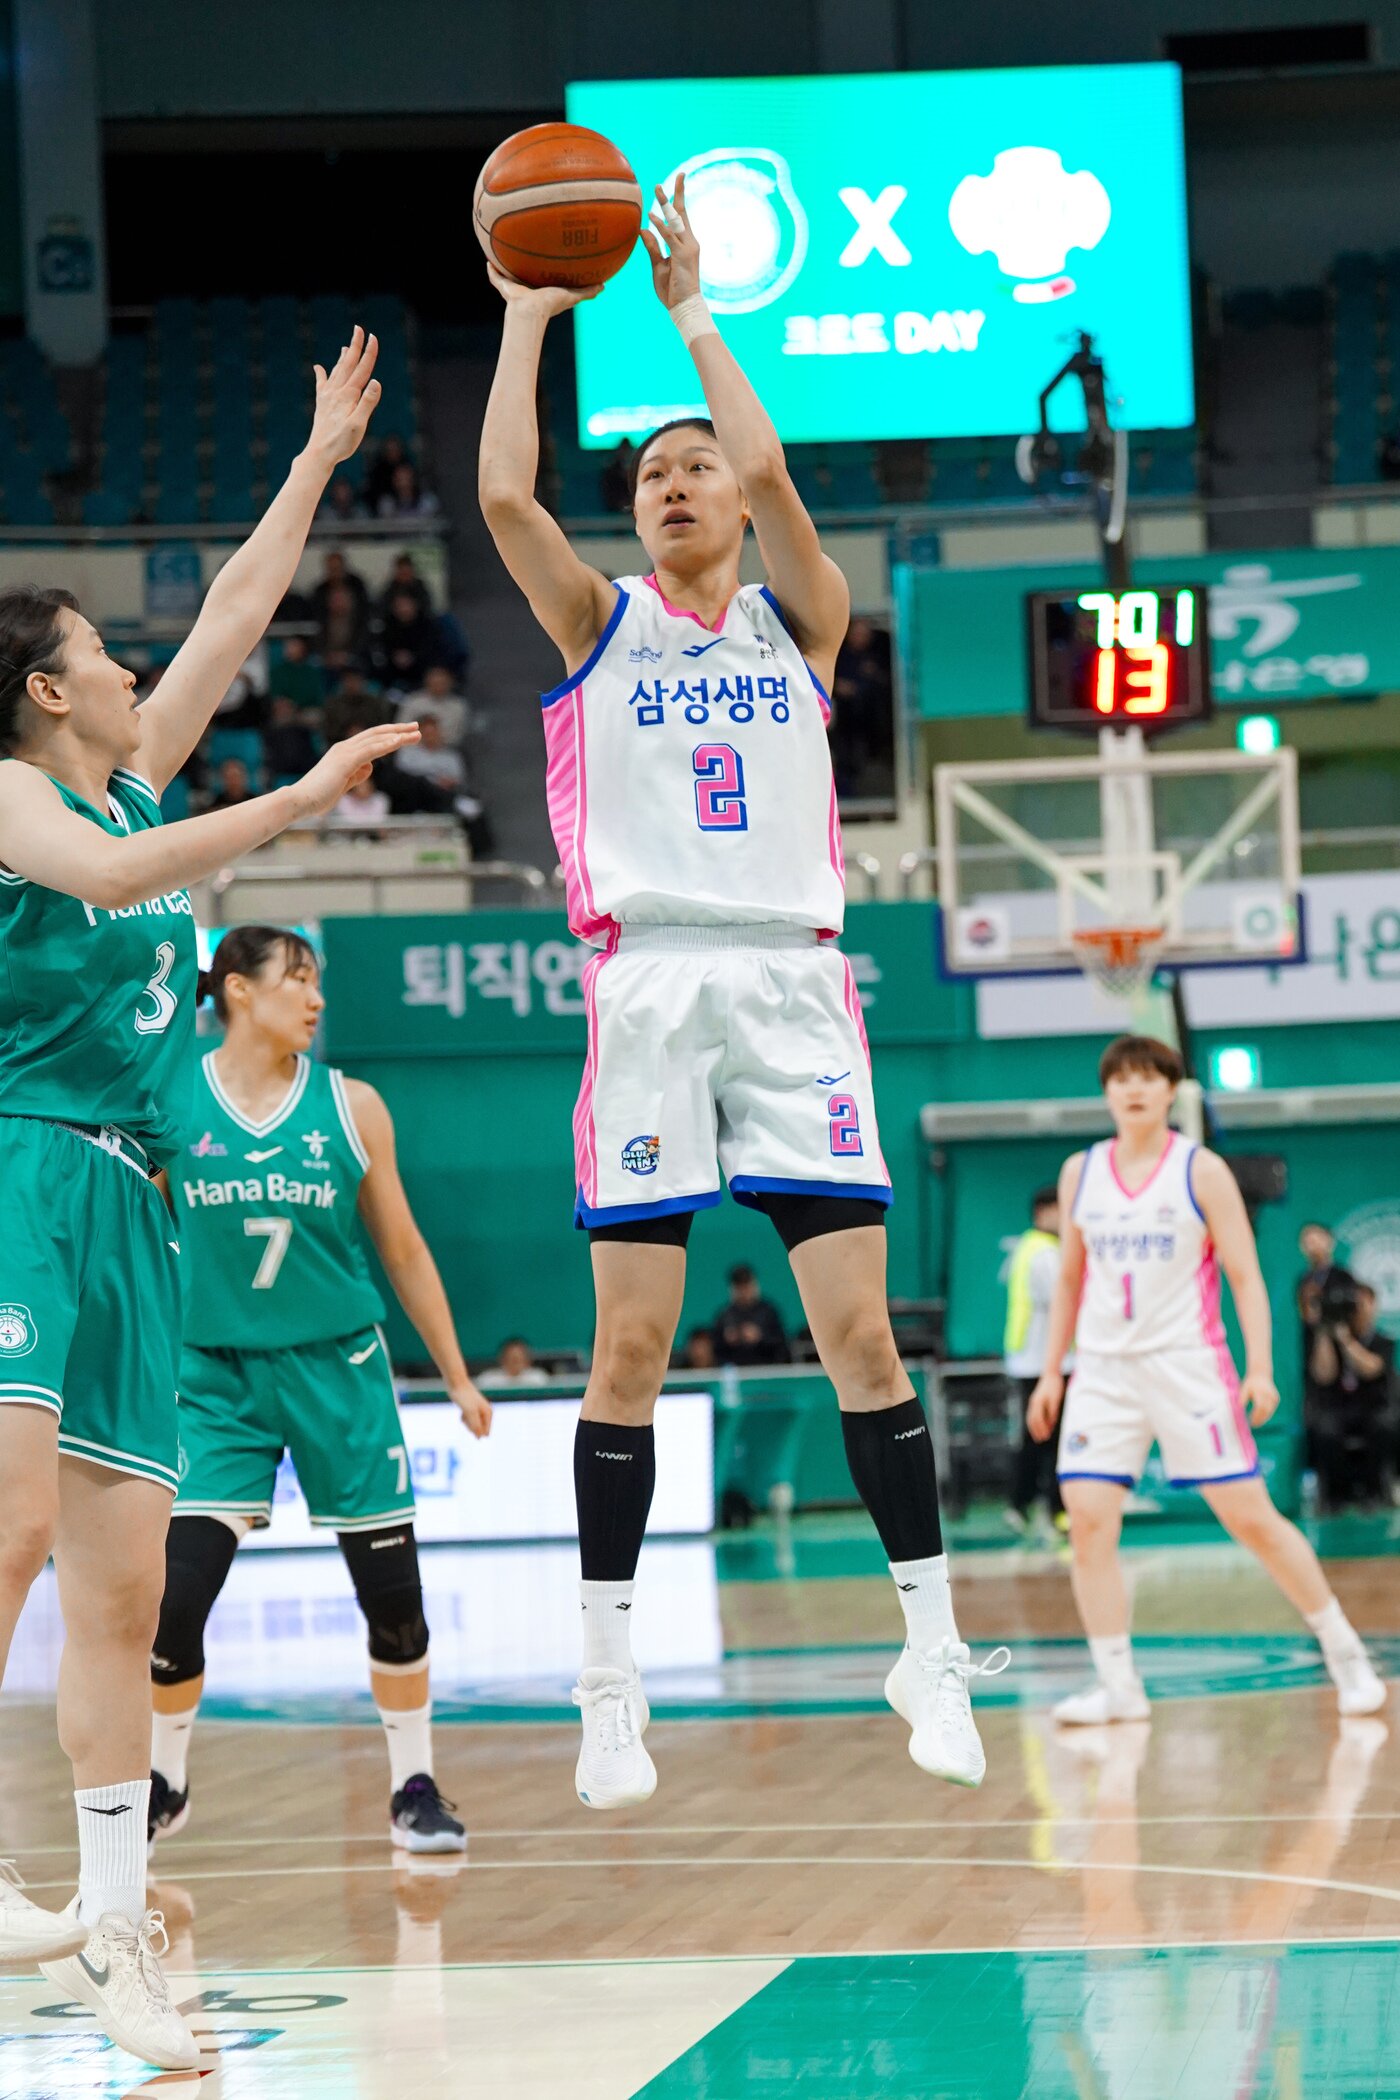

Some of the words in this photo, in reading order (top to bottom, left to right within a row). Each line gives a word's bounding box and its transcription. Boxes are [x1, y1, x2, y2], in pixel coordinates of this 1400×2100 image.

[562, 229, 598, 247] FIBA
[894, 309, 986, 354] DAY
[628, 675, 790, 727] 삼성생명
[1095, 643, 1169, 714] 13
[692, 743, 749, 832] 2
[134, 941, 178, 1035] 3
[828, 1094, 864, 1156] 2
[183, 1179, 263, 1208] Hana
[267, 1173, 337, 1208] Bank
[244, 1217, 293, 1289] 7
[1122, 1271, 1136, 1321] 1
[387, 1445, 408, 1494] 7
